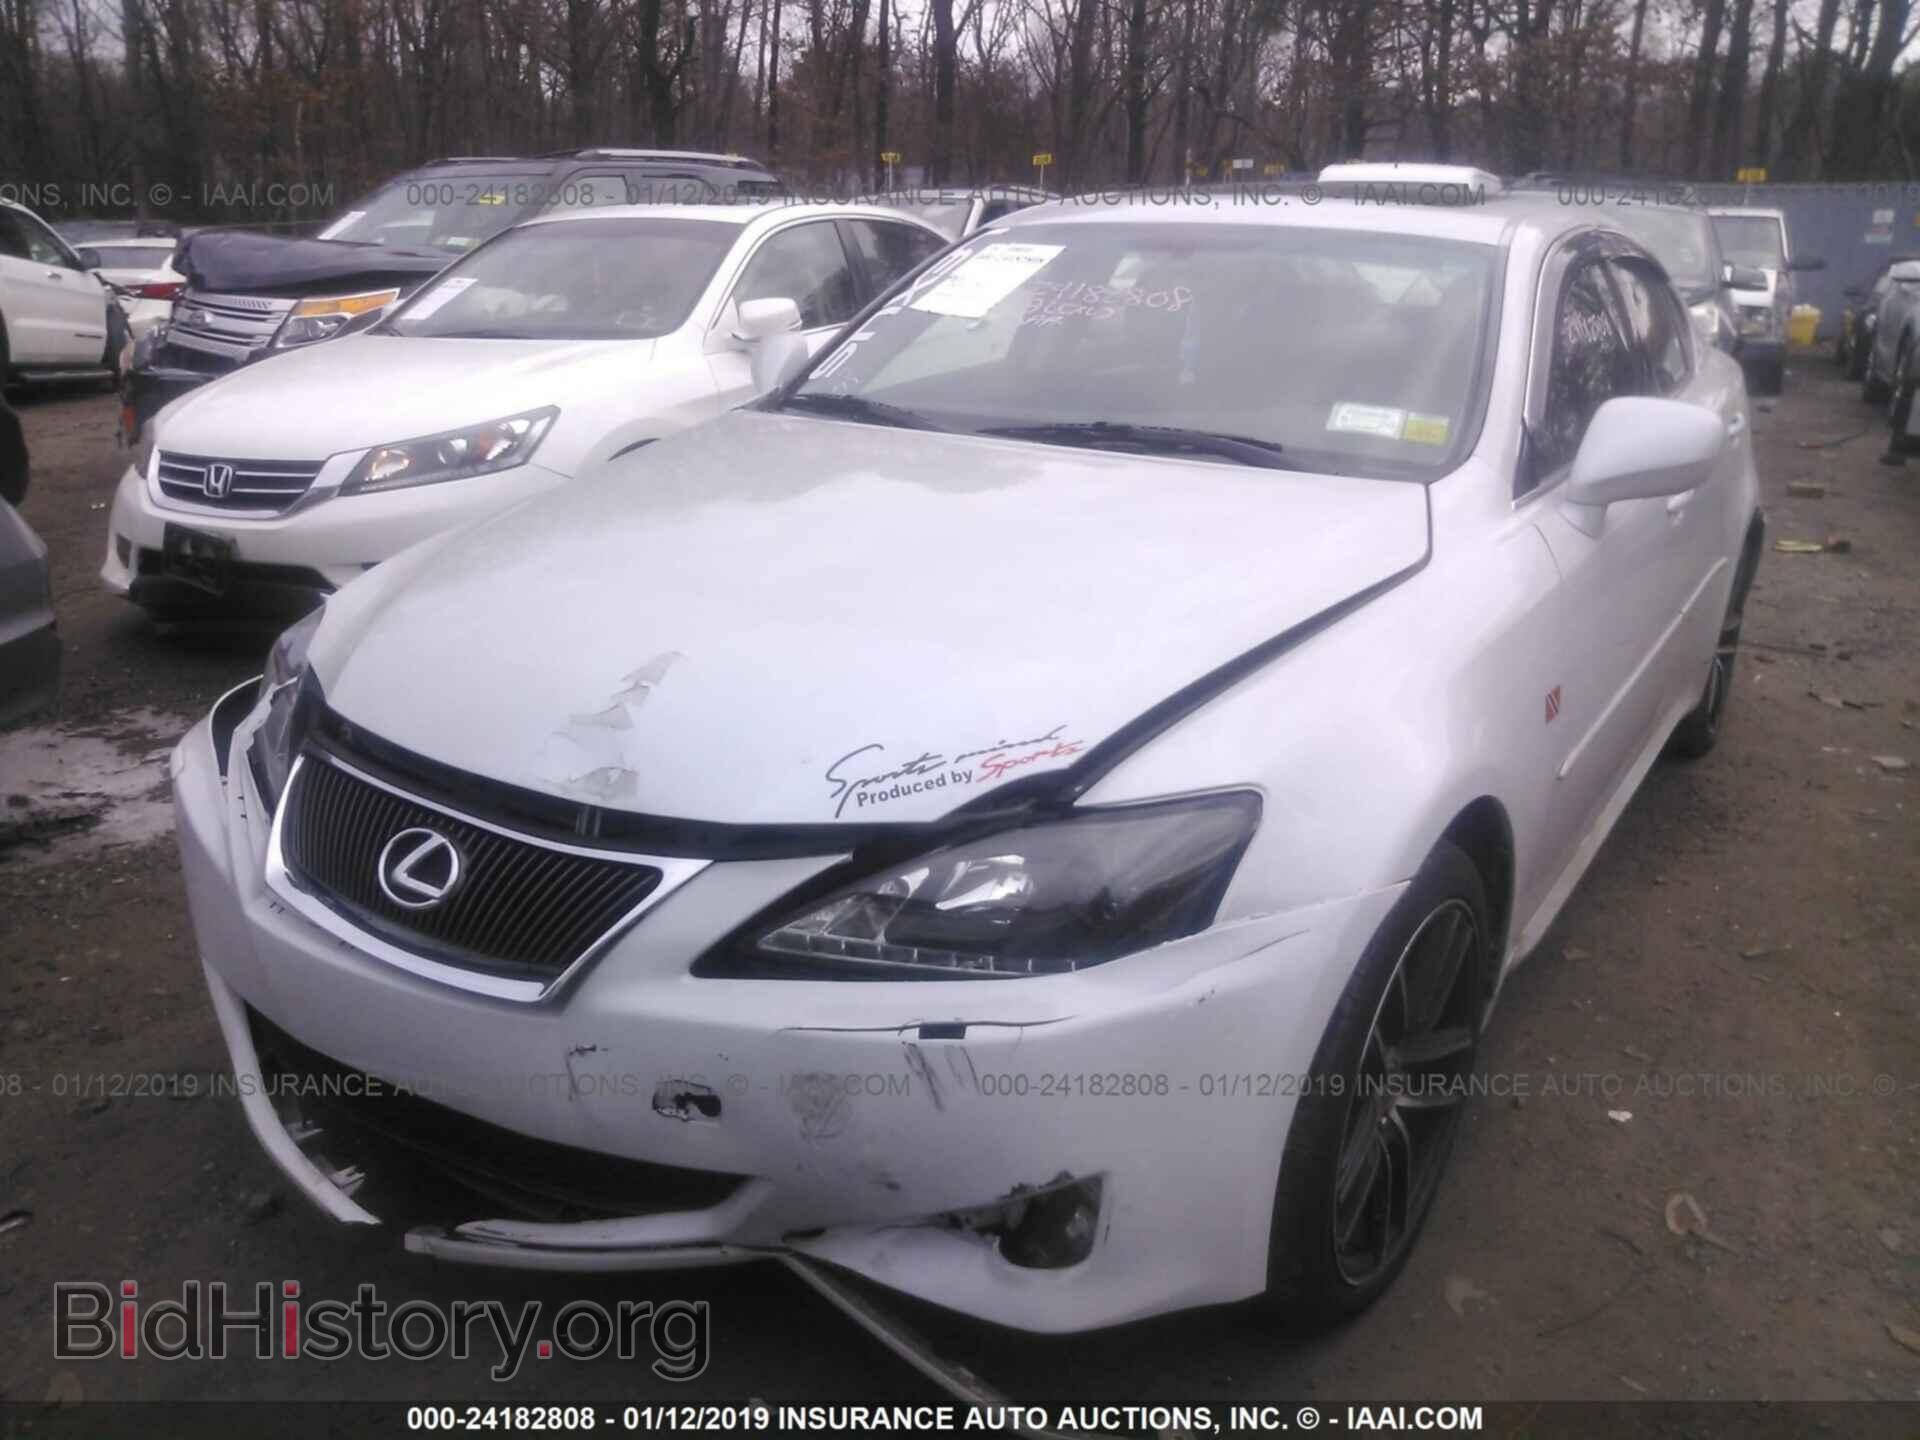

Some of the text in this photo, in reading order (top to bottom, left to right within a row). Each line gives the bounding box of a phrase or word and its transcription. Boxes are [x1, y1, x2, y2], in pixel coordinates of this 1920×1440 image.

[856, 740, 1084, 807] Produced by Sports
